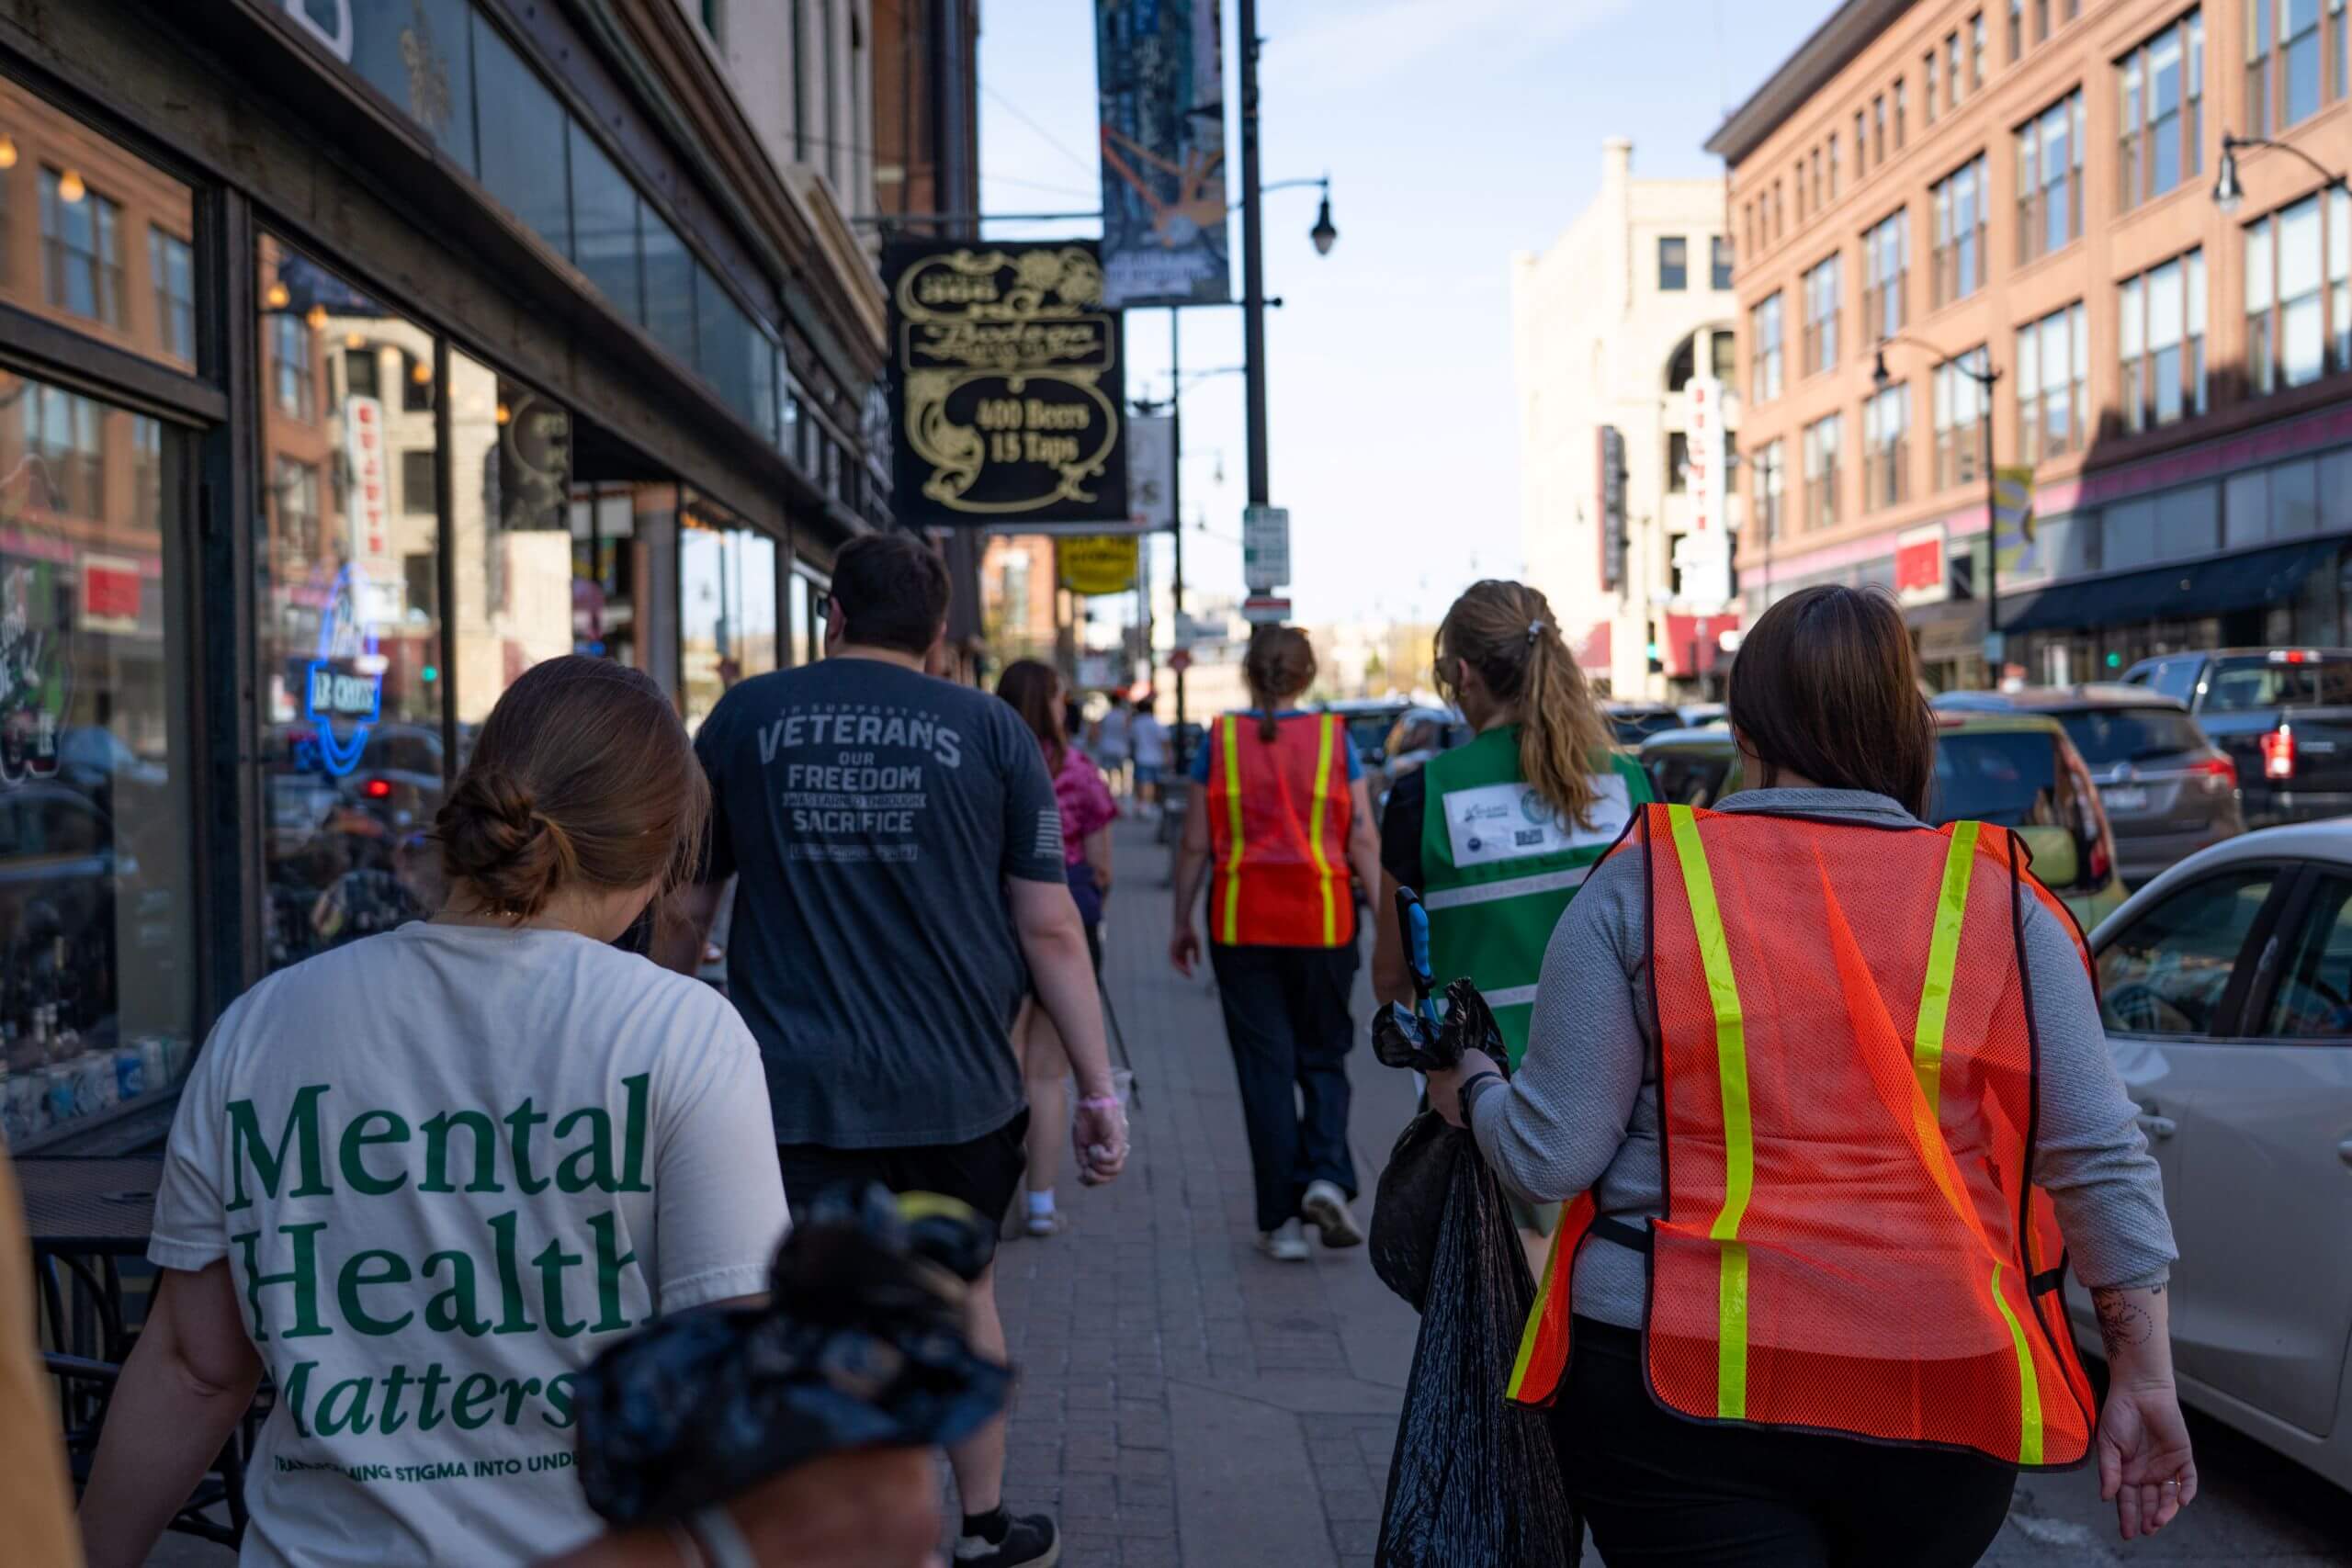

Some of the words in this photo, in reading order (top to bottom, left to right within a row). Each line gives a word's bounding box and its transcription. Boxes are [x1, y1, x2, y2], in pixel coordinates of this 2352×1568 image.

[1025, 399, 1091, 430] Beers
[991, 432, 1021, 463] 15
[1023, 432, 1080, 469] Taps
[812, 704, 909, 716] SUPPORT
[757, 714, 961, 768] VETERANS
[838, 751, 875, 766] OUR
[788, 764, 922, 791] FREEDOM
[793, 810, 914, 832] SACRIFICE
[226, 1072, 652, 1212] Mental
[232, 1210, 656, 1342] Health
[396, 1461, 468, 1483] STIGMA
[474, 1459, 522, 1478] INTO
